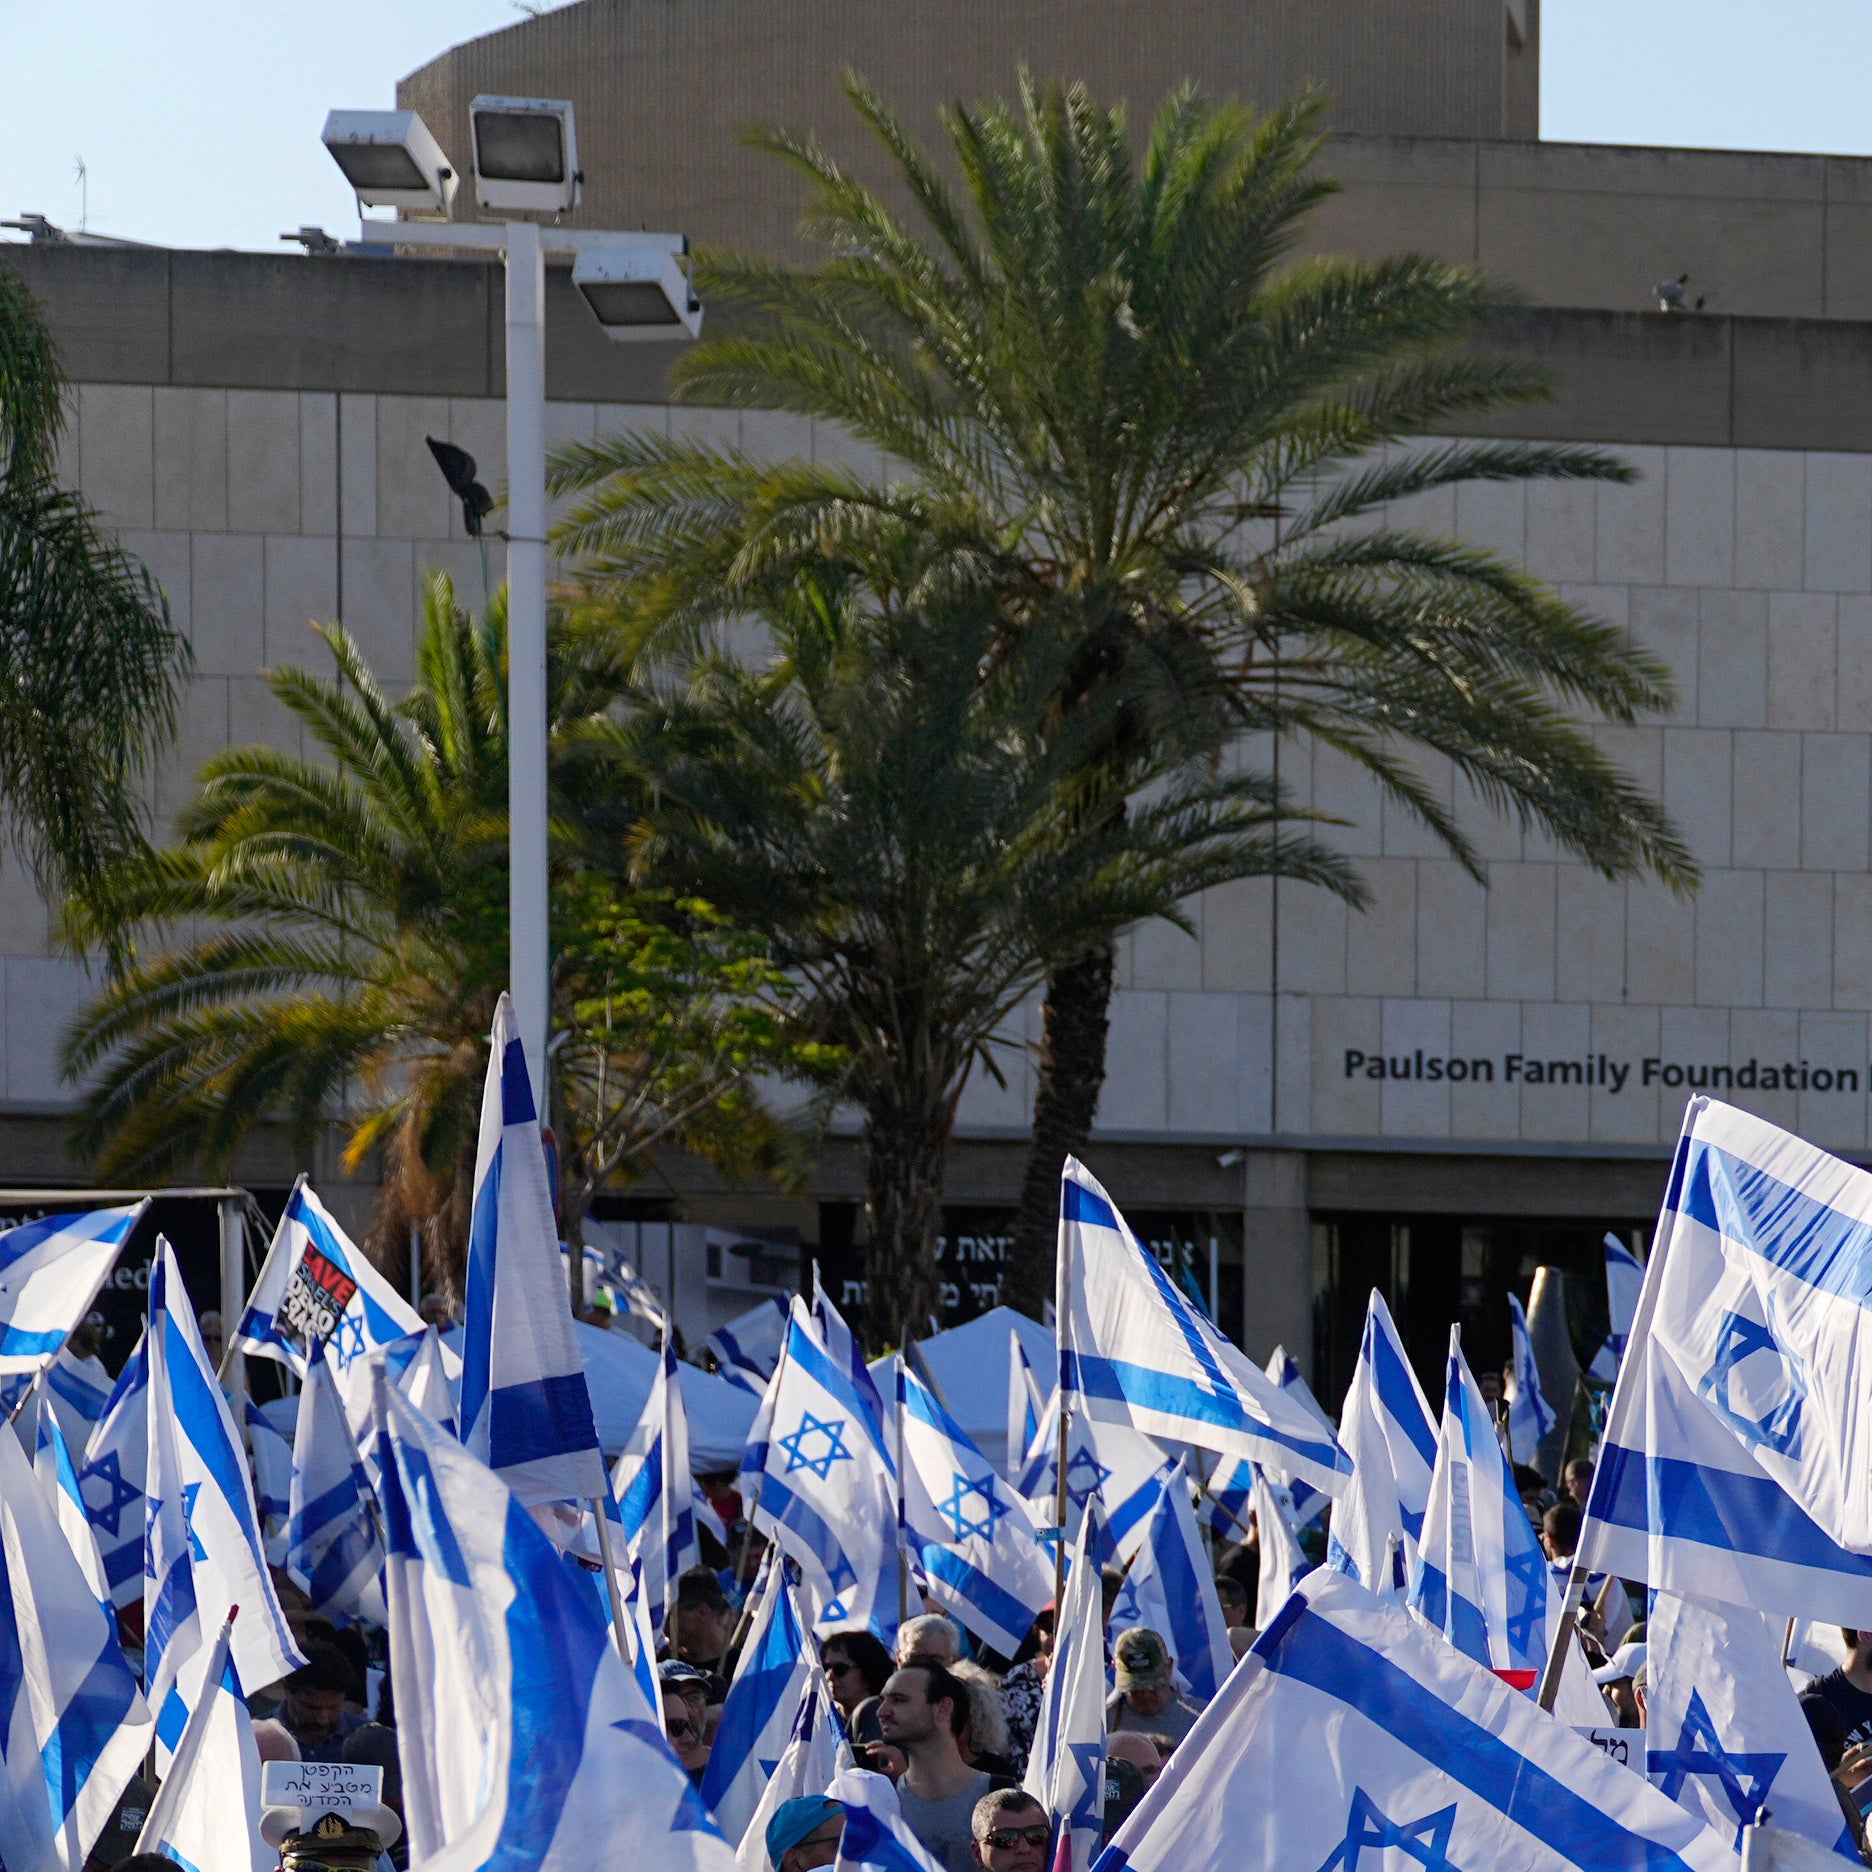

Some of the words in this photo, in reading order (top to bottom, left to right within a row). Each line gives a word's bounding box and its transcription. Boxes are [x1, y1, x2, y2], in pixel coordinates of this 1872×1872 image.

[1346, 1050, 1493, 1082] Paulson
[1505, 1055, 1629, 1094] Family
[1643, 1059, 1858, 1092] Foundation
[300, 1764, 354, 1782] הקפטן
[285, 1780, 312, 1792] את
